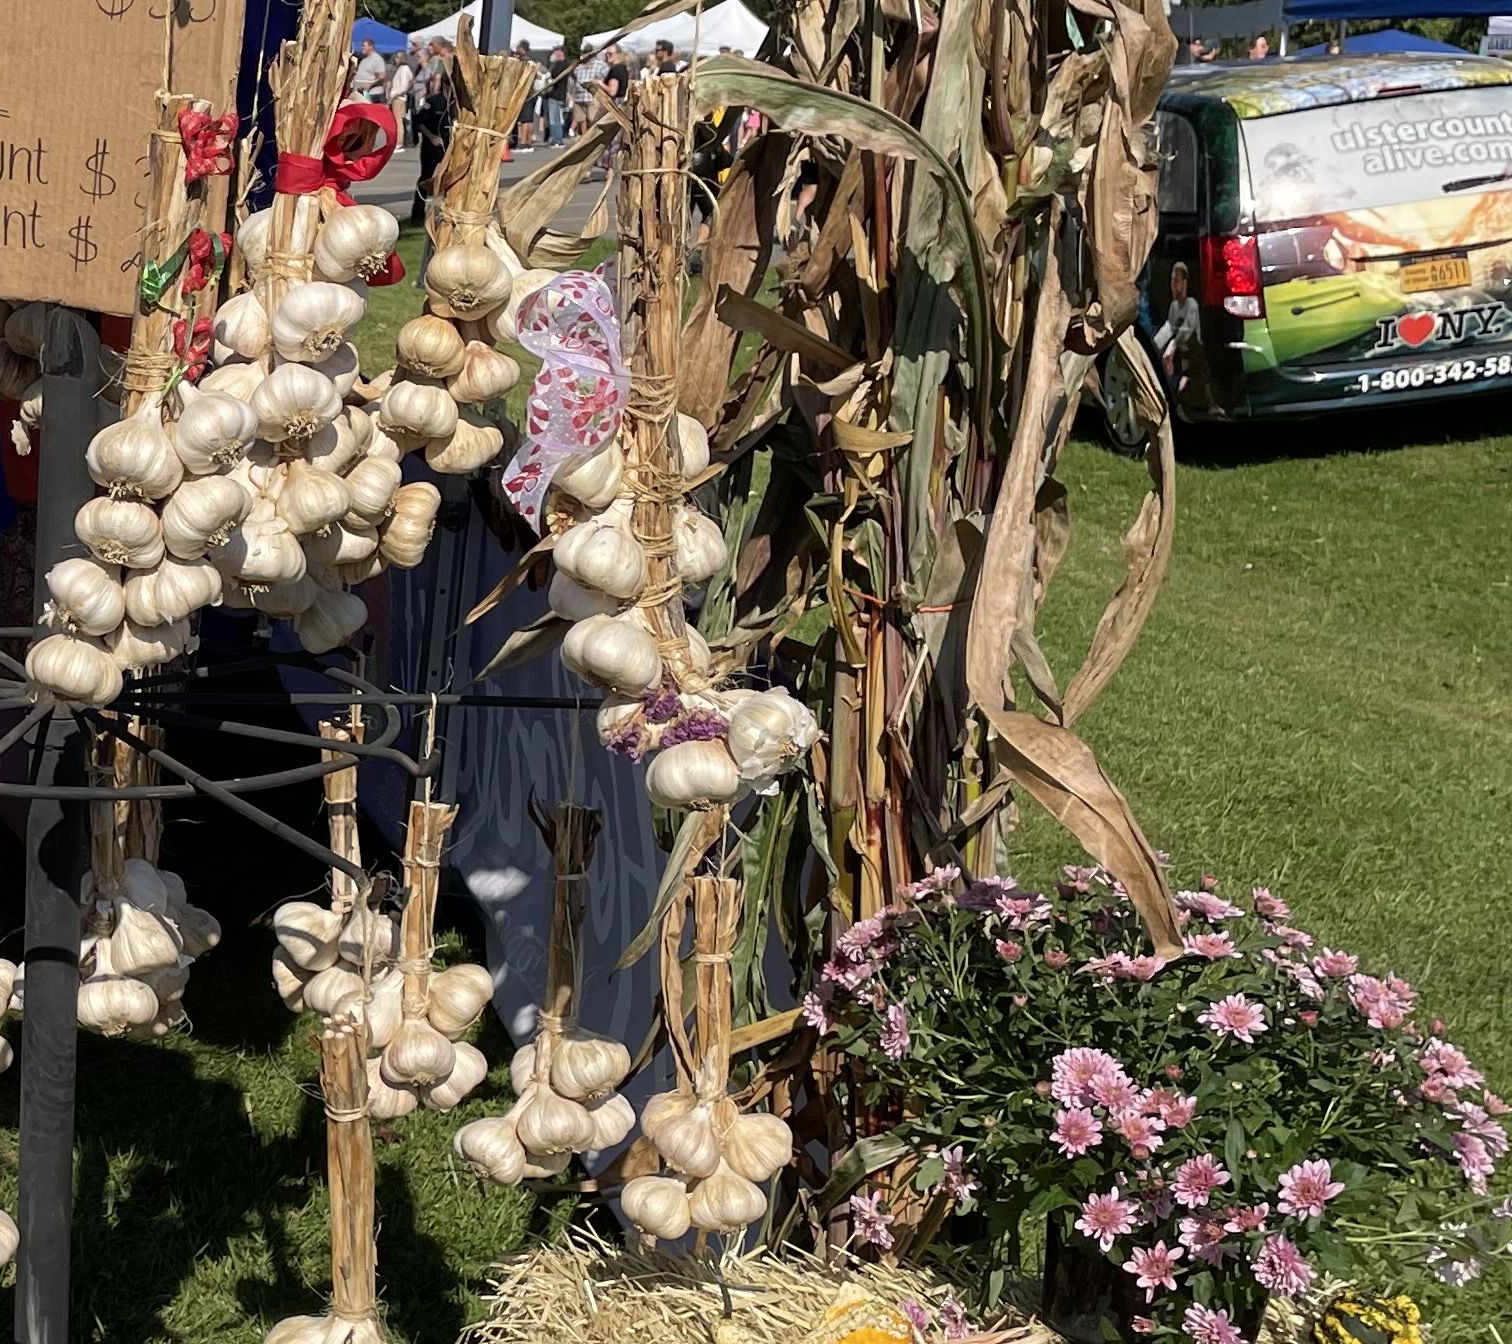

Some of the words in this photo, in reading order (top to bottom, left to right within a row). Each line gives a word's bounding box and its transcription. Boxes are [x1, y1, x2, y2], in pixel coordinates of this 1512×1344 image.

[1363, 139, 1512, 174] alive.com
[1376, 318, 1396, 348] I
[1357, 355, 1512, 393] 1-800-342-58
